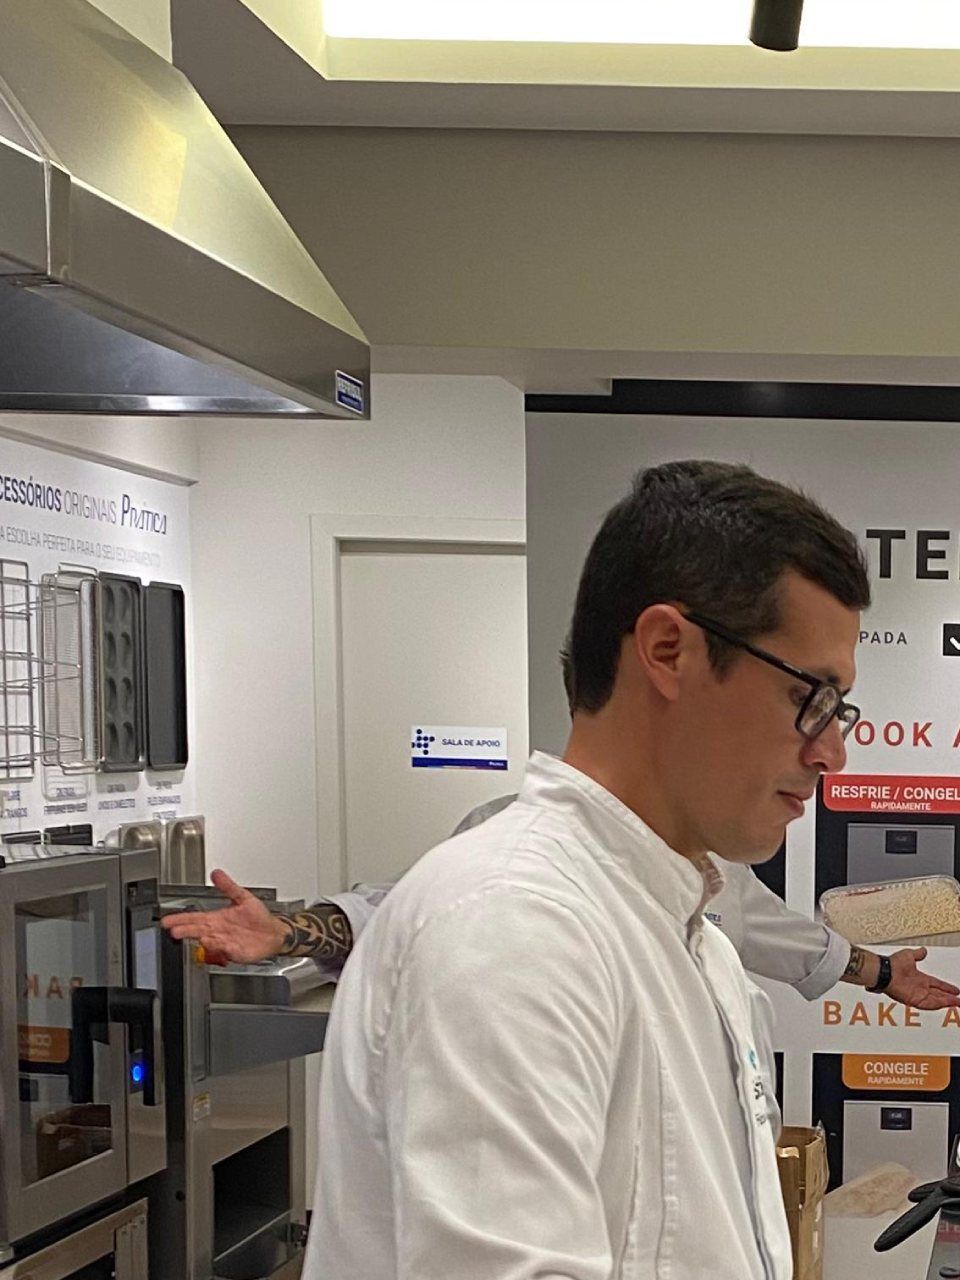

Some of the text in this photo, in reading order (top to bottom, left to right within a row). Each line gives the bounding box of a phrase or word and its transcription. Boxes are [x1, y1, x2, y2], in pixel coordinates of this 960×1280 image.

[64, 490, 116, 524] ORIGINAIS
[859, 631, 908, 645] PADA
[854, 720, 933, 747] OOK
[442, 738, 462, 746] SALA
[831, 785, 890, 799] RESFRIE
[870, 801, 931, 811] RAPIDAMENTE
[823, 1000, 922, 1027] BAKE
[863, 1062, 929, 1075] CONGELE
[867, 1077, 924, 1086] RAPIDAMENTE
